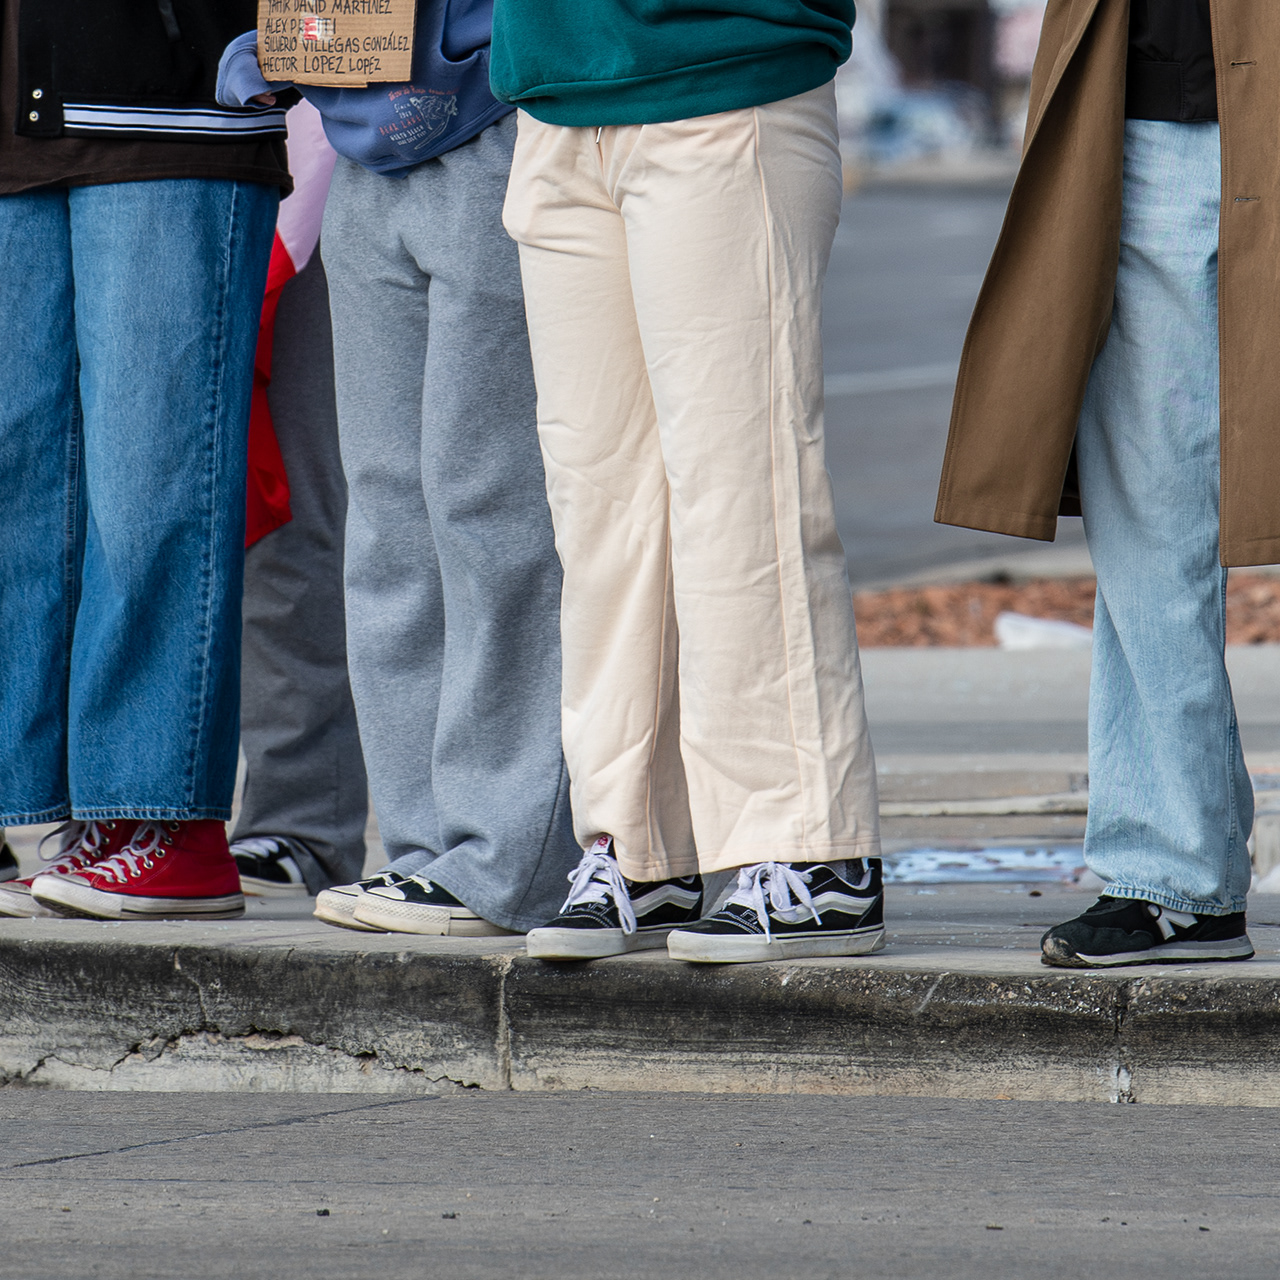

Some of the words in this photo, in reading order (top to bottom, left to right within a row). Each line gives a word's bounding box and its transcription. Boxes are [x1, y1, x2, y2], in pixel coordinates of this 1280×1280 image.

[265, 18, 287, 34] ALEX
[302, 37, 360, 53] VILLEGAS
[262, 56, 298, 73] HECTOR
[304, 55, 345, 74] LOPEZ
[349, 56, 381, 74] LOPEZ
